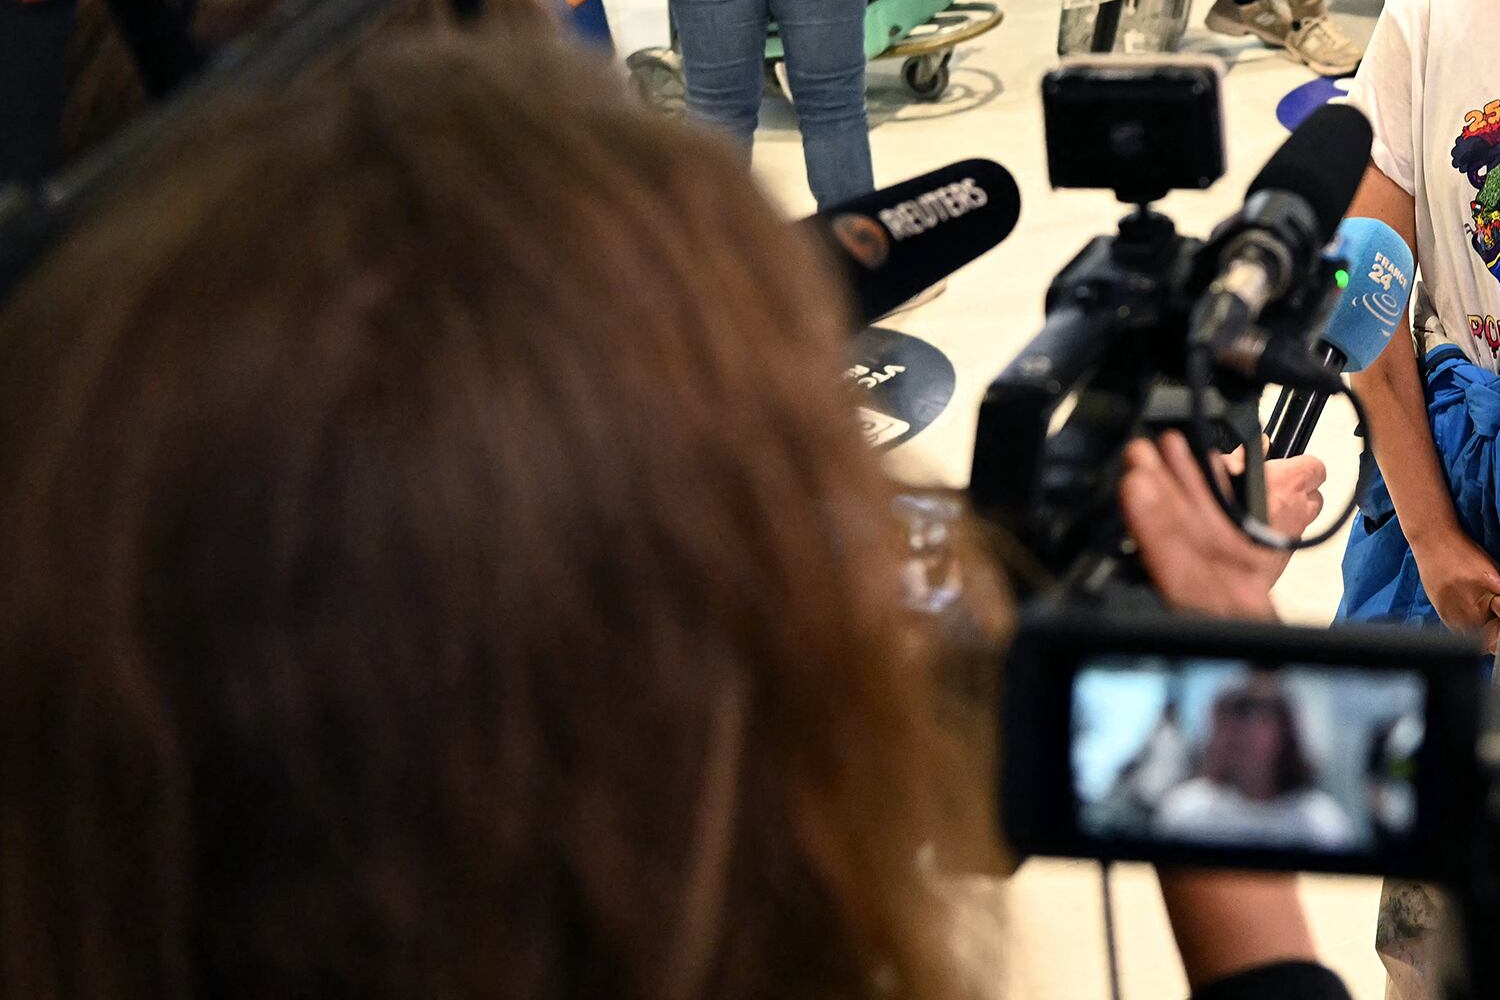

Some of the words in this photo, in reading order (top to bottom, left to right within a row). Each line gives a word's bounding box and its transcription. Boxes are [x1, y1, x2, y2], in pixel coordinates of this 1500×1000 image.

[878, 176, 988, 241] REUTERS
[1368, 263, 1393, 291] 24
[1375, 251, 1408, 291] FRANCE
